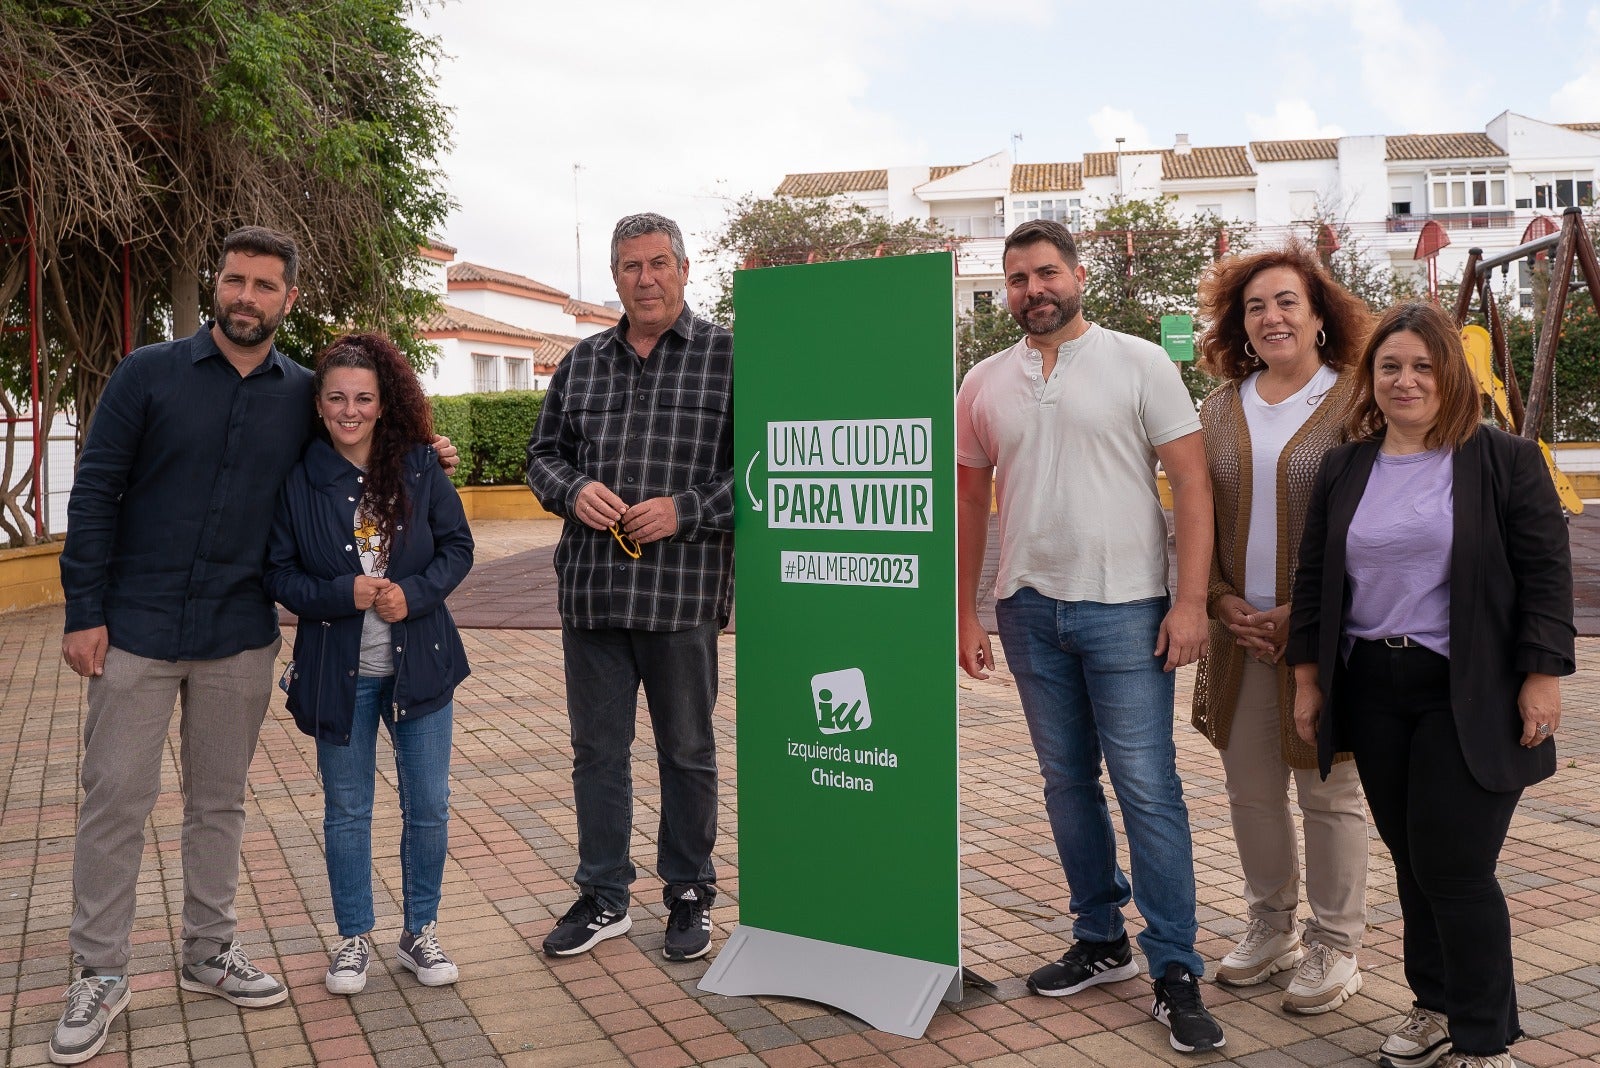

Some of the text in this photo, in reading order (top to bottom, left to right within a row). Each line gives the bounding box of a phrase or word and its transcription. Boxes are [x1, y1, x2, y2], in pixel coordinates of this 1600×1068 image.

[773, 424, 928, 466] UNA CIUDAD
[773, 484, 928, 525] PARA VIVIR
[784, 555, 914, 584] #PALMERO2023
[787, 738, 898, 768] izquierda unida
[811, 767, 874, 791] Chiclana
